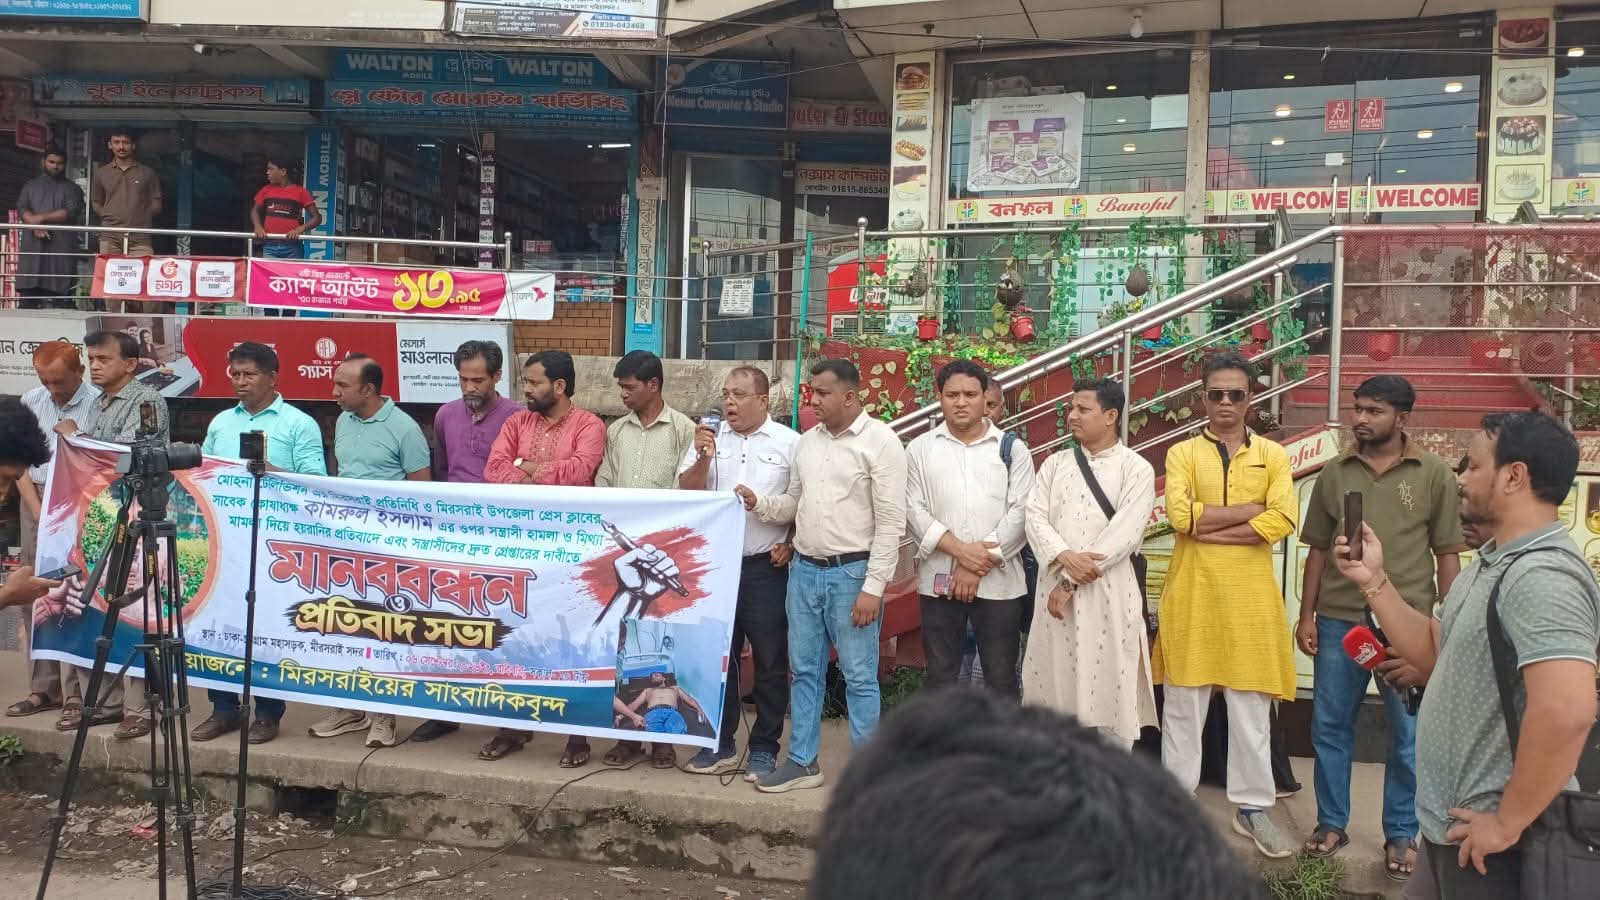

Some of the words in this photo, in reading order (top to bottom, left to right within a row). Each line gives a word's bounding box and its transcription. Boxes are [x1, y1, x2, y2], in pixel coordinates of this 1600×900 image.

[346, 54, 433, 72] WALTON
[507, 59, 593, 77] WALTON
[402, 72, 433, 80] MOBILE
[562, 77, 593, 86] MOBILE
[697, 96, 743, 112] Computer
[752, 98, 783, 113] Studio
[1096, 196, 1179, 215] Banoful
[1250, 190, 1349, 210] WELCOME
[1376, 187, 1480, 208] WELCOME
[988, 201, 1054, 217] বনফুল
[269, 276, 317, 295] ক্যাশ
[320, 277, 379, 299] আউট
[400, 337, 426, 349] মেসার্স
[298, 364, 334, 380] গ্যাস
[217, 474, 252, 489] মোহনা
[258, 476, 308, 496] টেলিভিশন
[375, 497, 419, 513] প্রতিনিধি
[423, 503, 432, 513] ও
[437, 500, 484, 517] মিরসরাই
[487, 503, 535, 520] উপজেলা
[539, 509, 562, 523] প্রেস
[567, 511, 603, 526] ক্লাবের
[212, 494, 246, 508] সাবেক
[304, 499, 371, 525] কামরুল
[374, 506, 433, 532] ইসলাম
[438, 521, 455, 534] এর
[460, 523, 485, 537] ওপর
[488, 525, 522, 540] সন্ত্রাসী
[527, 530, 558, 544] হামলা
[563, 533, 572, 543] ও
[576, 529, 603, 547] মিথ্যা
[266, 516, 290, 533] দিয়ে
[293, 519, 332, 538] হয়রানির
[334, 527, 381, 545] প্রতিবাদে
[384, 534, 407, 549] এবং
[411, 536, 466, 554] সন্ত্রাসীদের
[468, 542, 491, 558] দ্রুত
[494, 545, 540, 562] গ্রেপ্তারের
[543, 548, 581, 565] দাবীতে
[266, 539, 537, 618] মানববন্ধন
[295, 596, 417, 646] প্রতিবাদ
[423, 618, 495, 650] সভা
[346, 646, 364, 657] সদর
[279, 658, 417, 699] মিরসরাইয়ের
[424, 680, 569, 724] সাংবাদিকবৃন্দ
